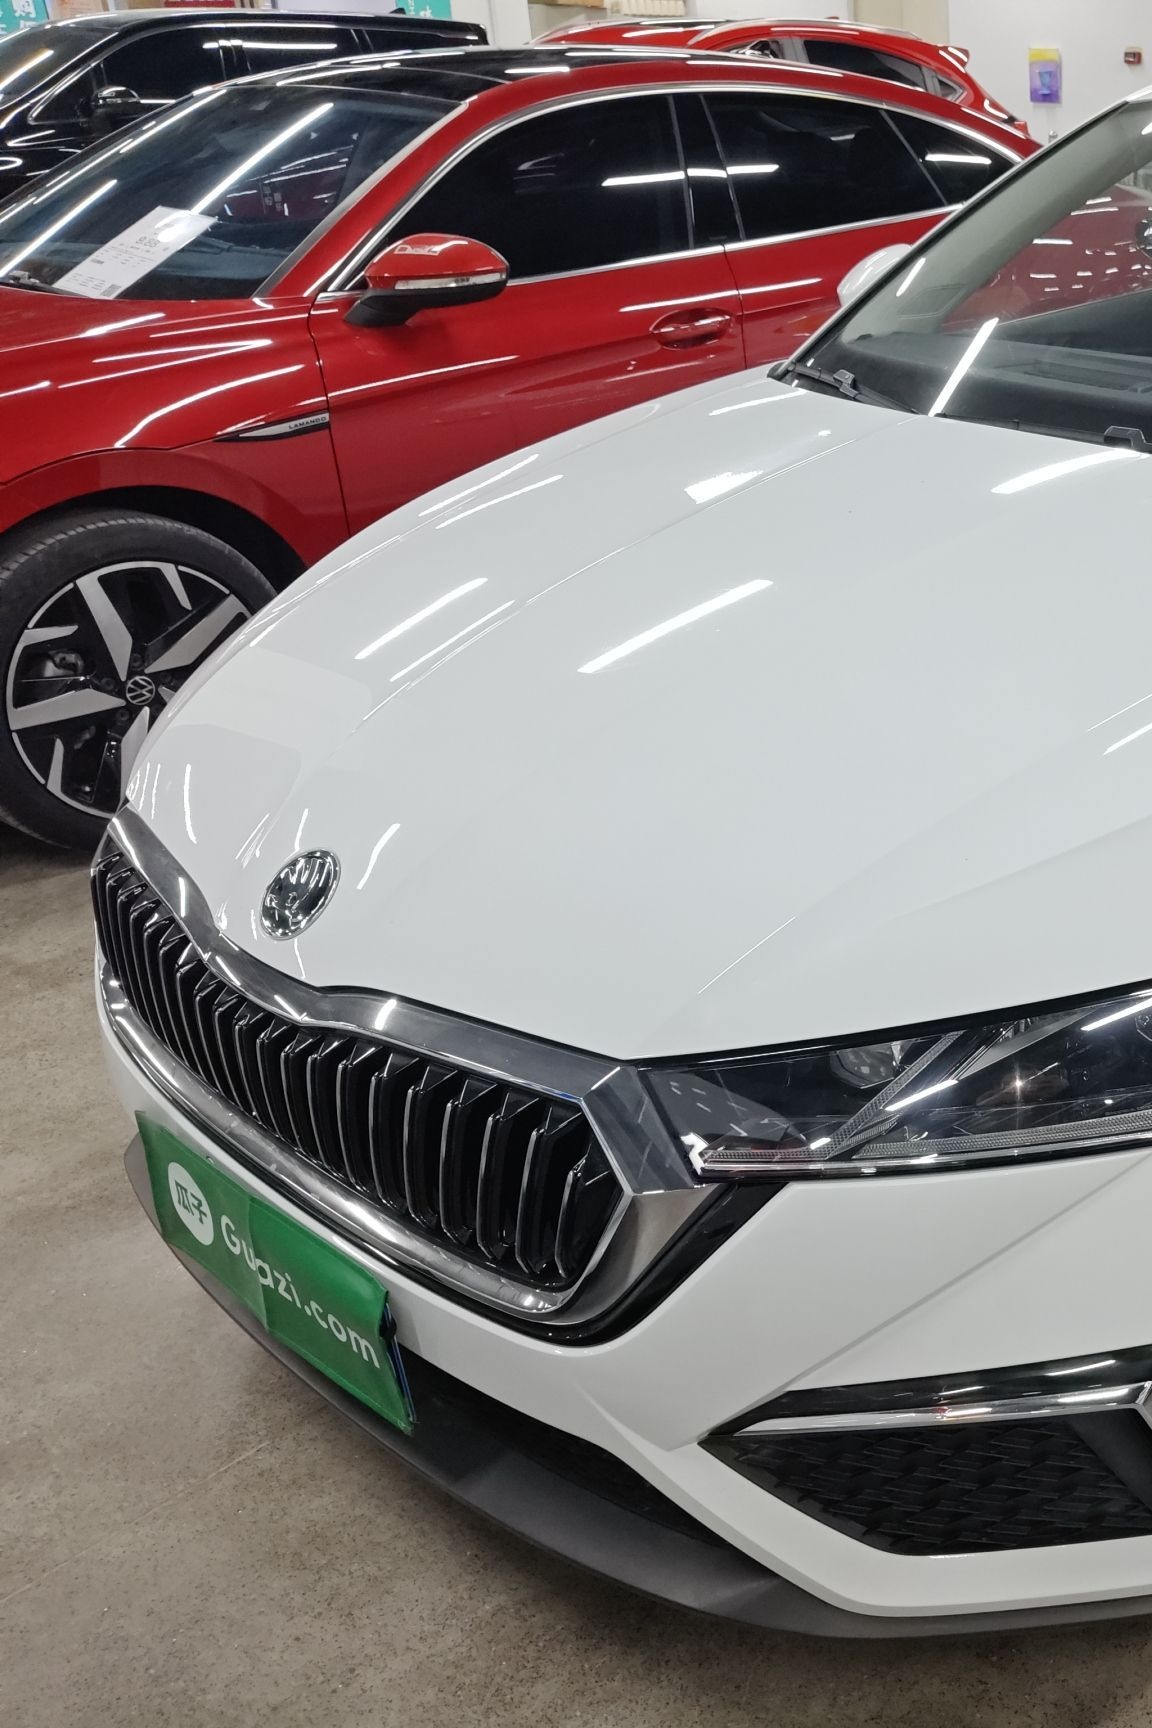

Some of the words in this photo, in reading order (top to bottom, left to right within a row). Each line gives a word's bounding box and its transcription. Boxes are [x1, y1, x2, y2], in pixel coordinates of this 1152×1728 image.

[288, 416, 327, 430] LAMANDO
[174, 1180, 208, 1225] 瓜子
[220, 1214, 381, 1369] Guazi.com
